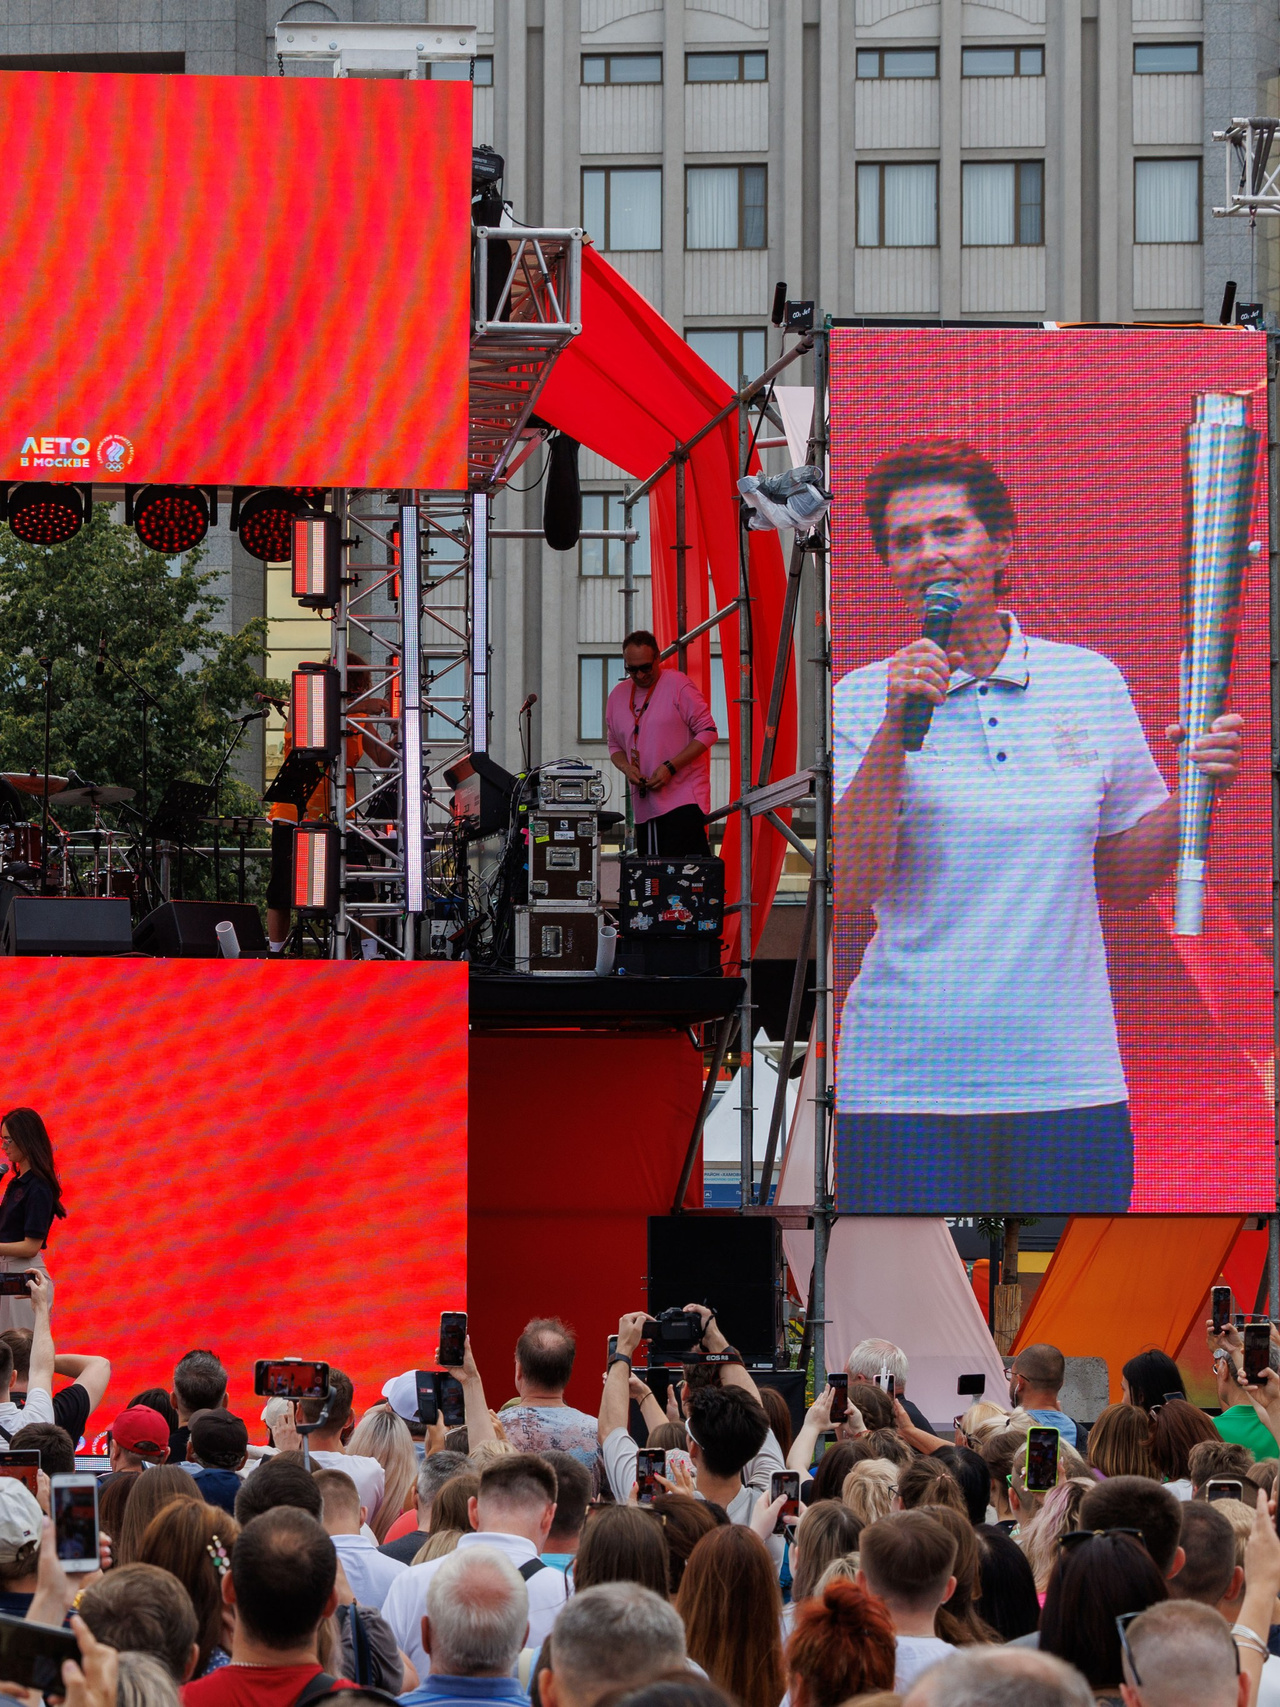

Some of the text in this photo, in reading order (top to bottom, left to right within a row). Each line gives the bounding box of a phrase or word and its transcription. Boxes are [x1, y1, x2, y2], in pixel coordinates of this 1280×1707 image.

[20, 436, 91, 456] ЛЕТО
[20, 457, 91, 468] В МОСКВЕ
